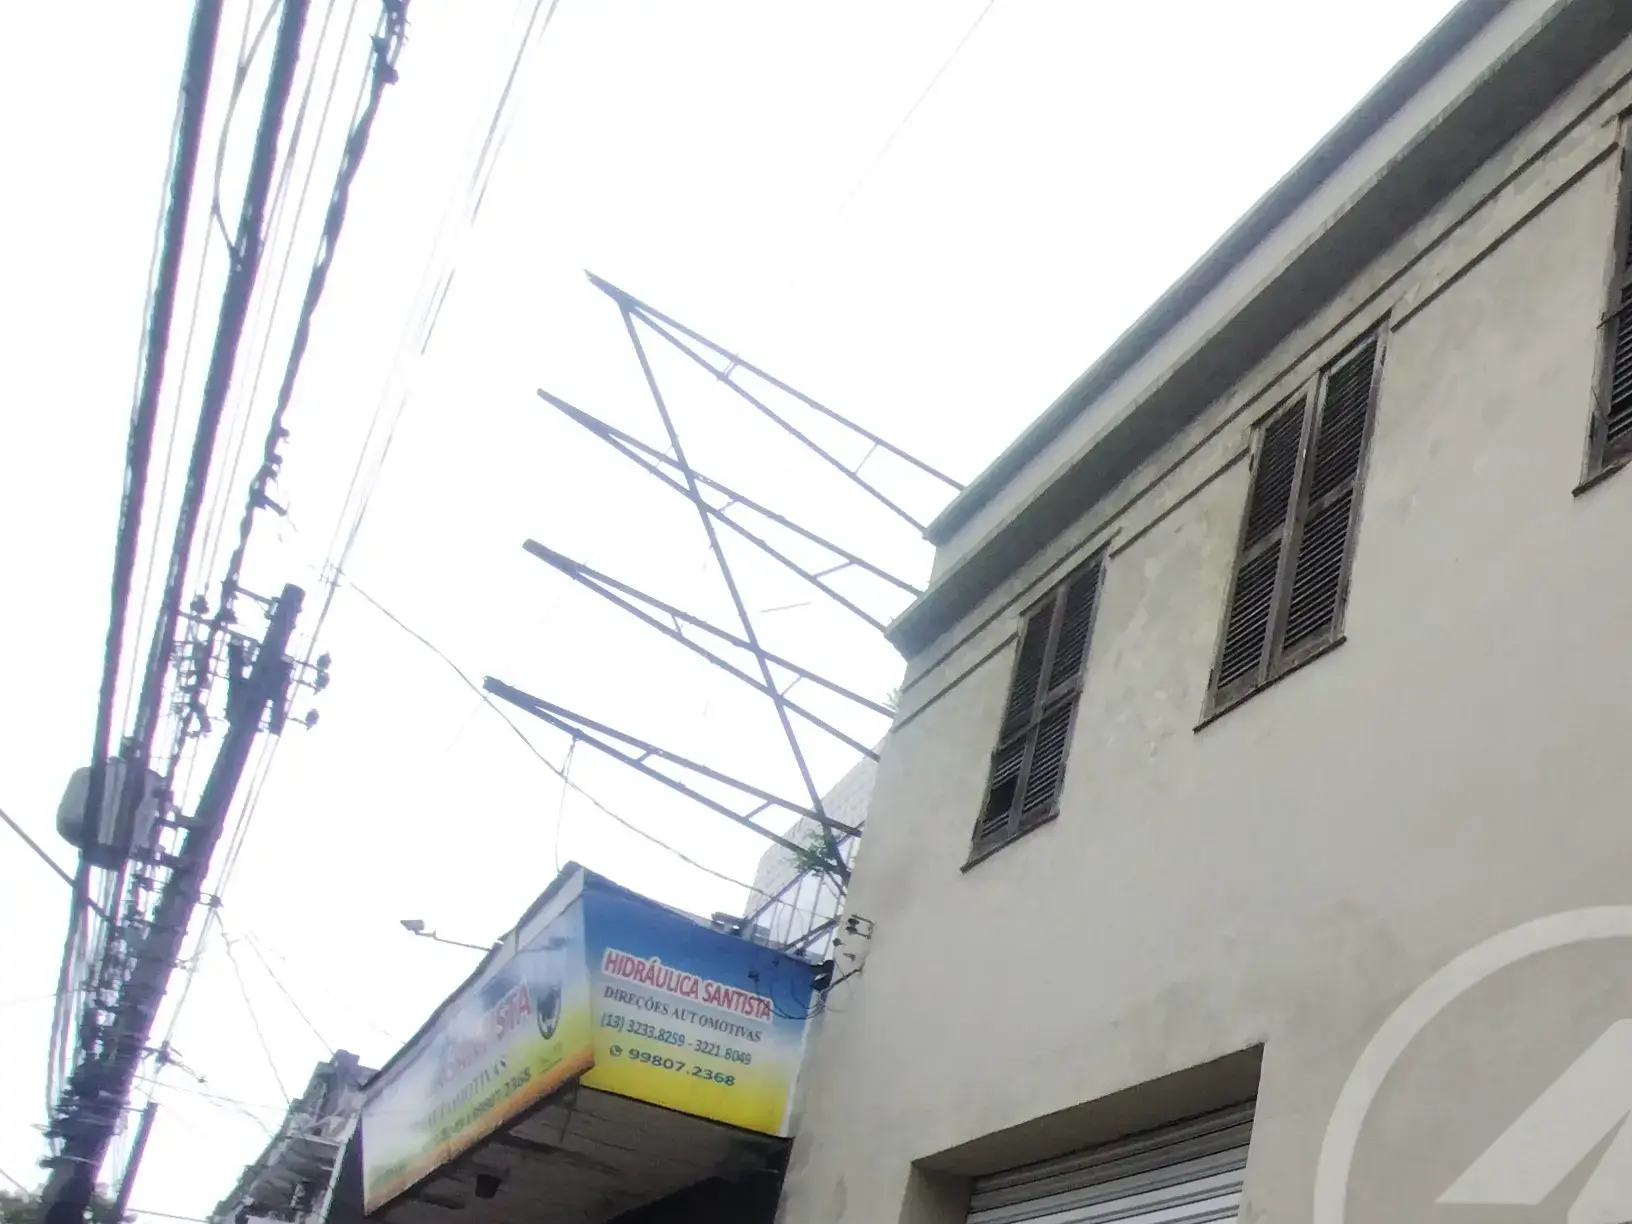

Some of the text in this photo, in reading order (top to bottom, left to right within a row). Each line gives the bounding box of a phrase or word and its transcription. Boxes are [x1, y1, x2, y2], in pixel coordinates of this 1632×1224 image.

[603, 950, 771, 1021] HIDRÁULICA SANTISTA
[600, 1012, 626, 1033] (13)
[627, 1018, 686, 1047] 3233.8259
[603, 986, 762, 1042] DIREÇÕES AUTOMOTIVAS
[628, 1047, 736, 1087] 99807.2368
